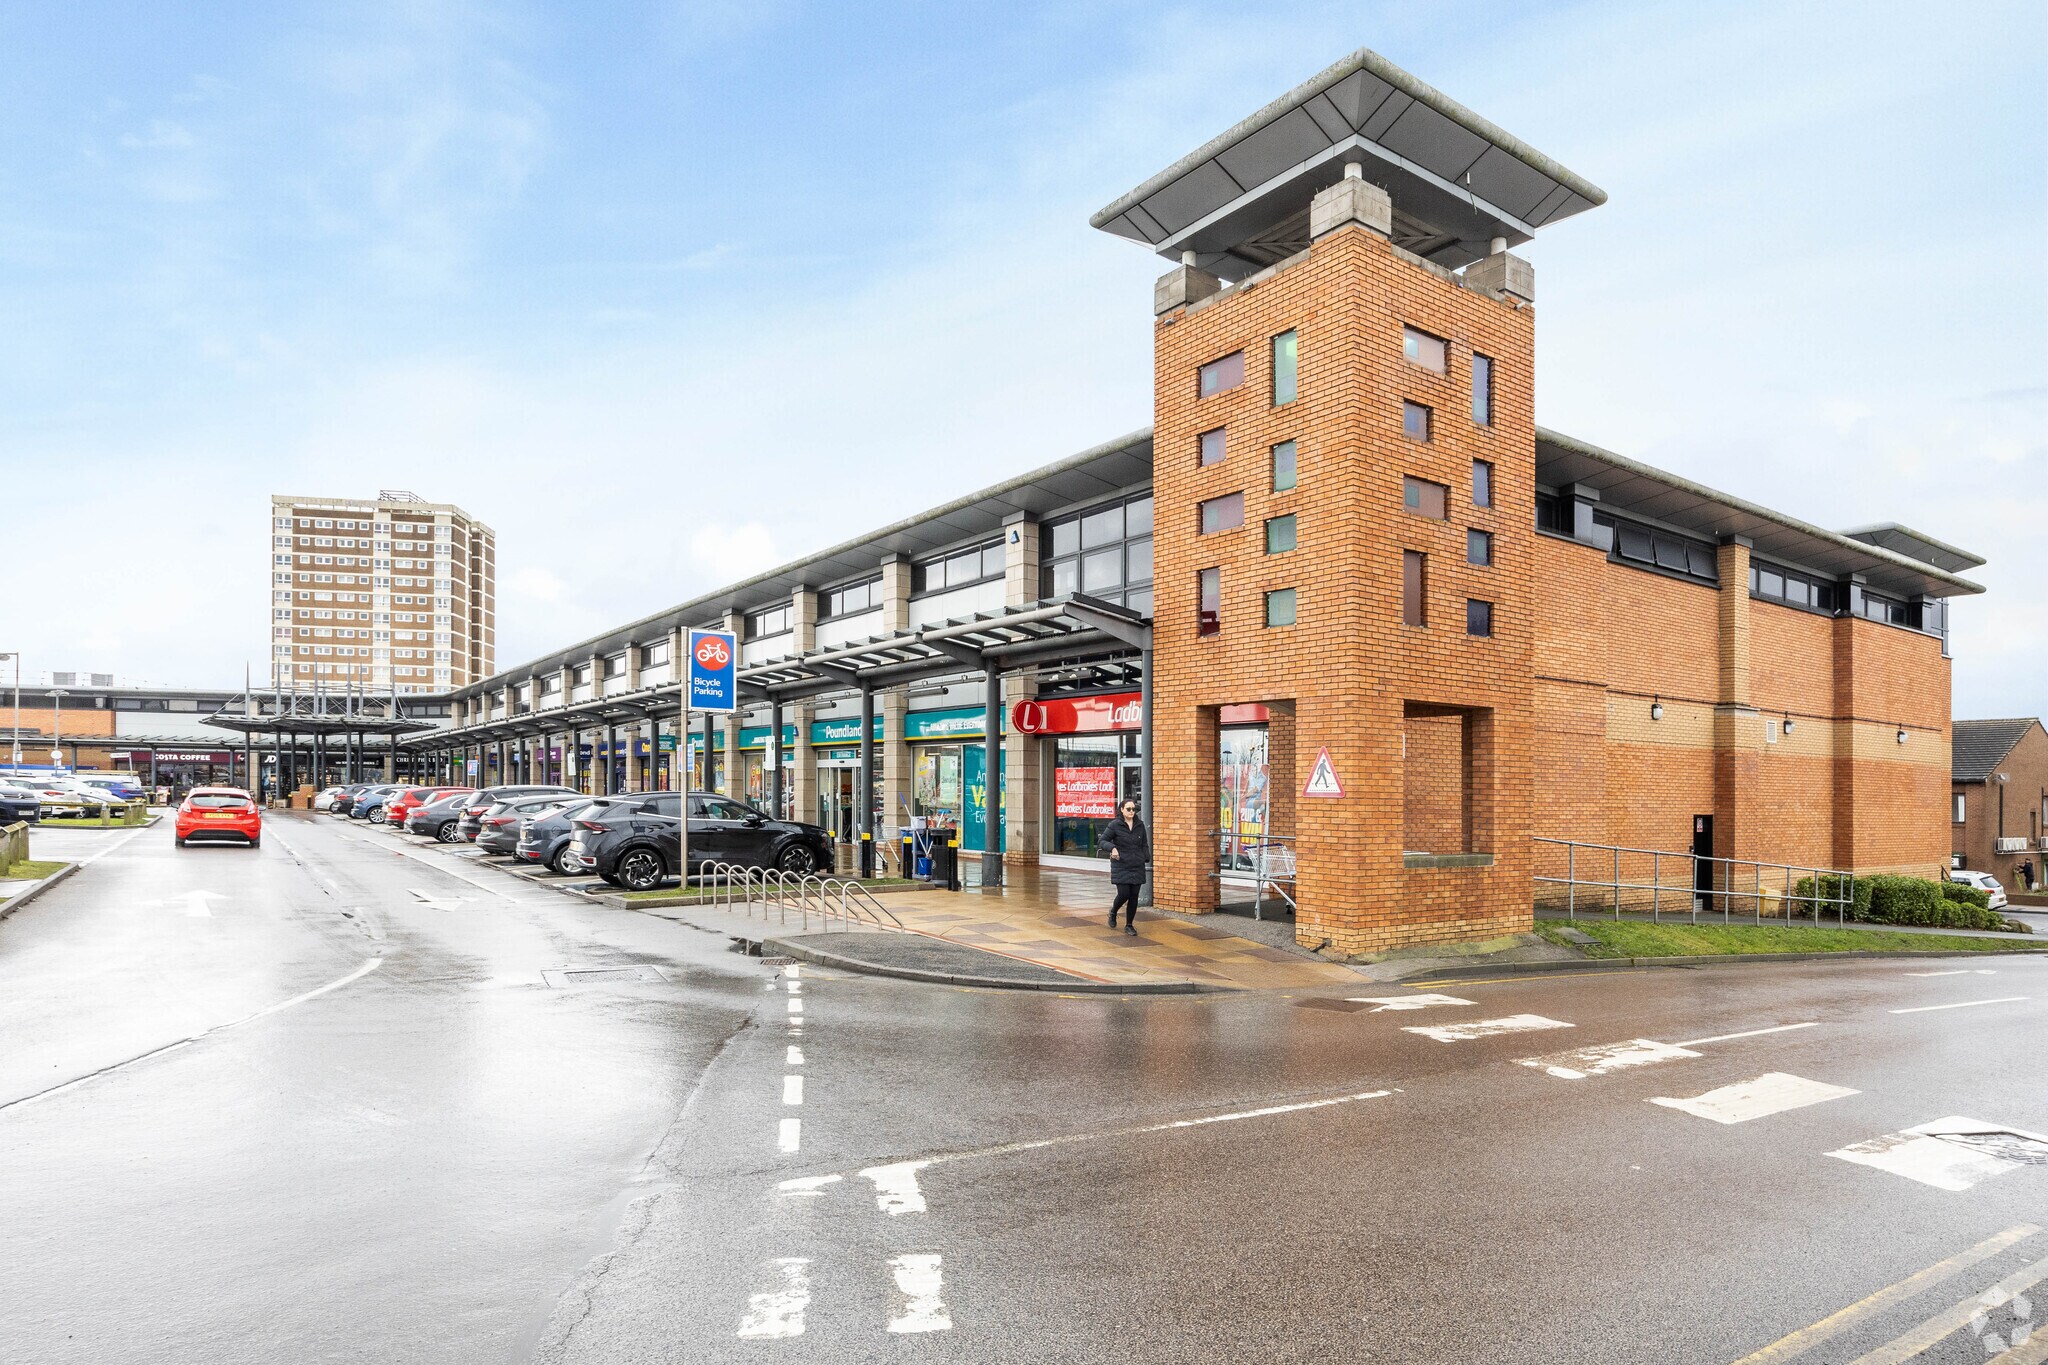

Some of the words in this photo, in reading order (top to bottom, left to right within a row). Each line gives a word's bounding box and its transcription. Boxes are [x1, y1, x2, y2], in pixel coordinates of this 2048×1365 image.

[694, 677, 721, 688] Bicycle
[694, 687, 723, 698] Parking
[1023, 704, 1035, 730] L
[825, 722, 863, 738] Poundland
[264, 755, 277, 763] JD
[1068, 781, 1098, 791] Ladbrokes
[1083, 803, 1114, 815] Ladbrokes
